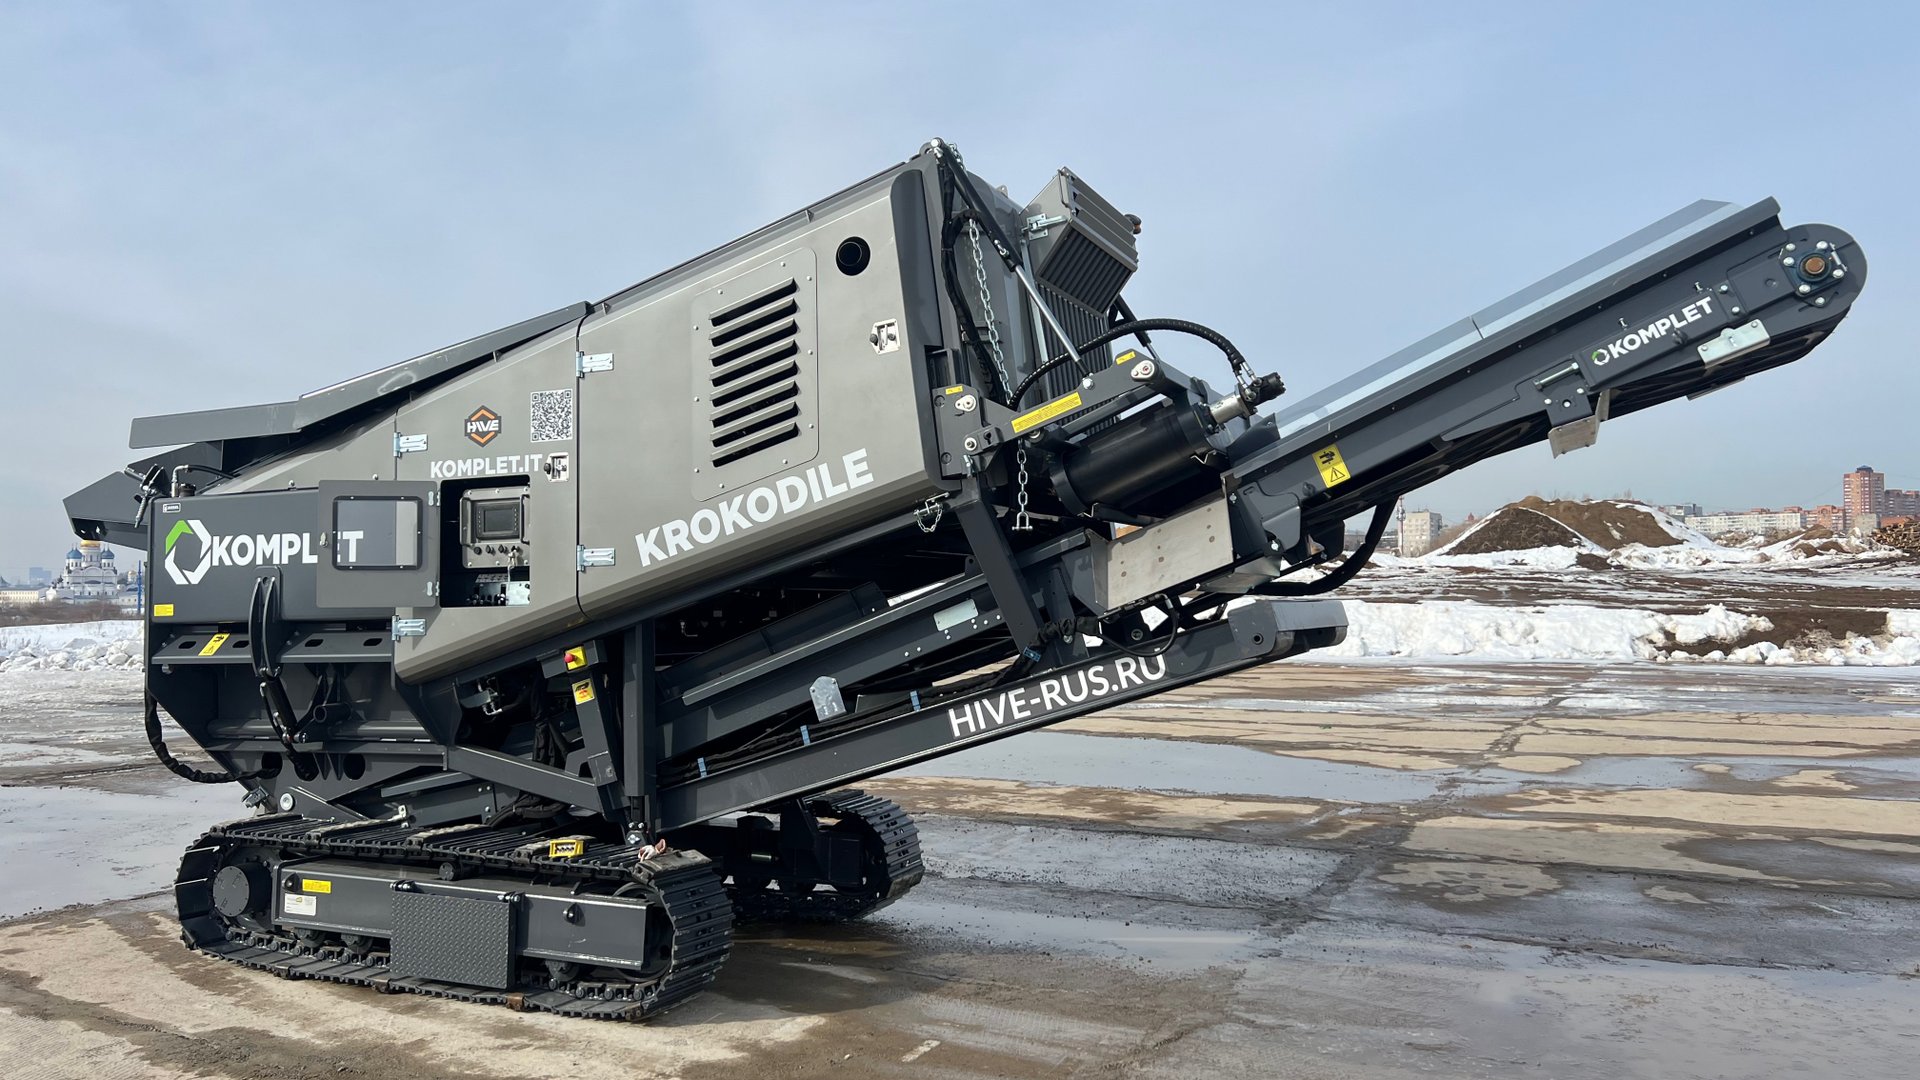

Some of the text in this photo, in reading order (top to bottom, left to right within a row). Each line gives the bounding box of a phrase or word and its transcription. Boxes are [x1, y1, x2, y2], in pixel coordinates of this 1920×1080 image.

[1607, 296, 1713, 359] KOMPLET
[466, 419, 499, 433] HIVE
[430, 453, 543, 479] KOMPLET.IT
[634, 448, 874, 567] KROKODILE
[211, 530, 364, 567] KOMPLT
[948, 647, 1167, 737] HIVE-RUS.RU
